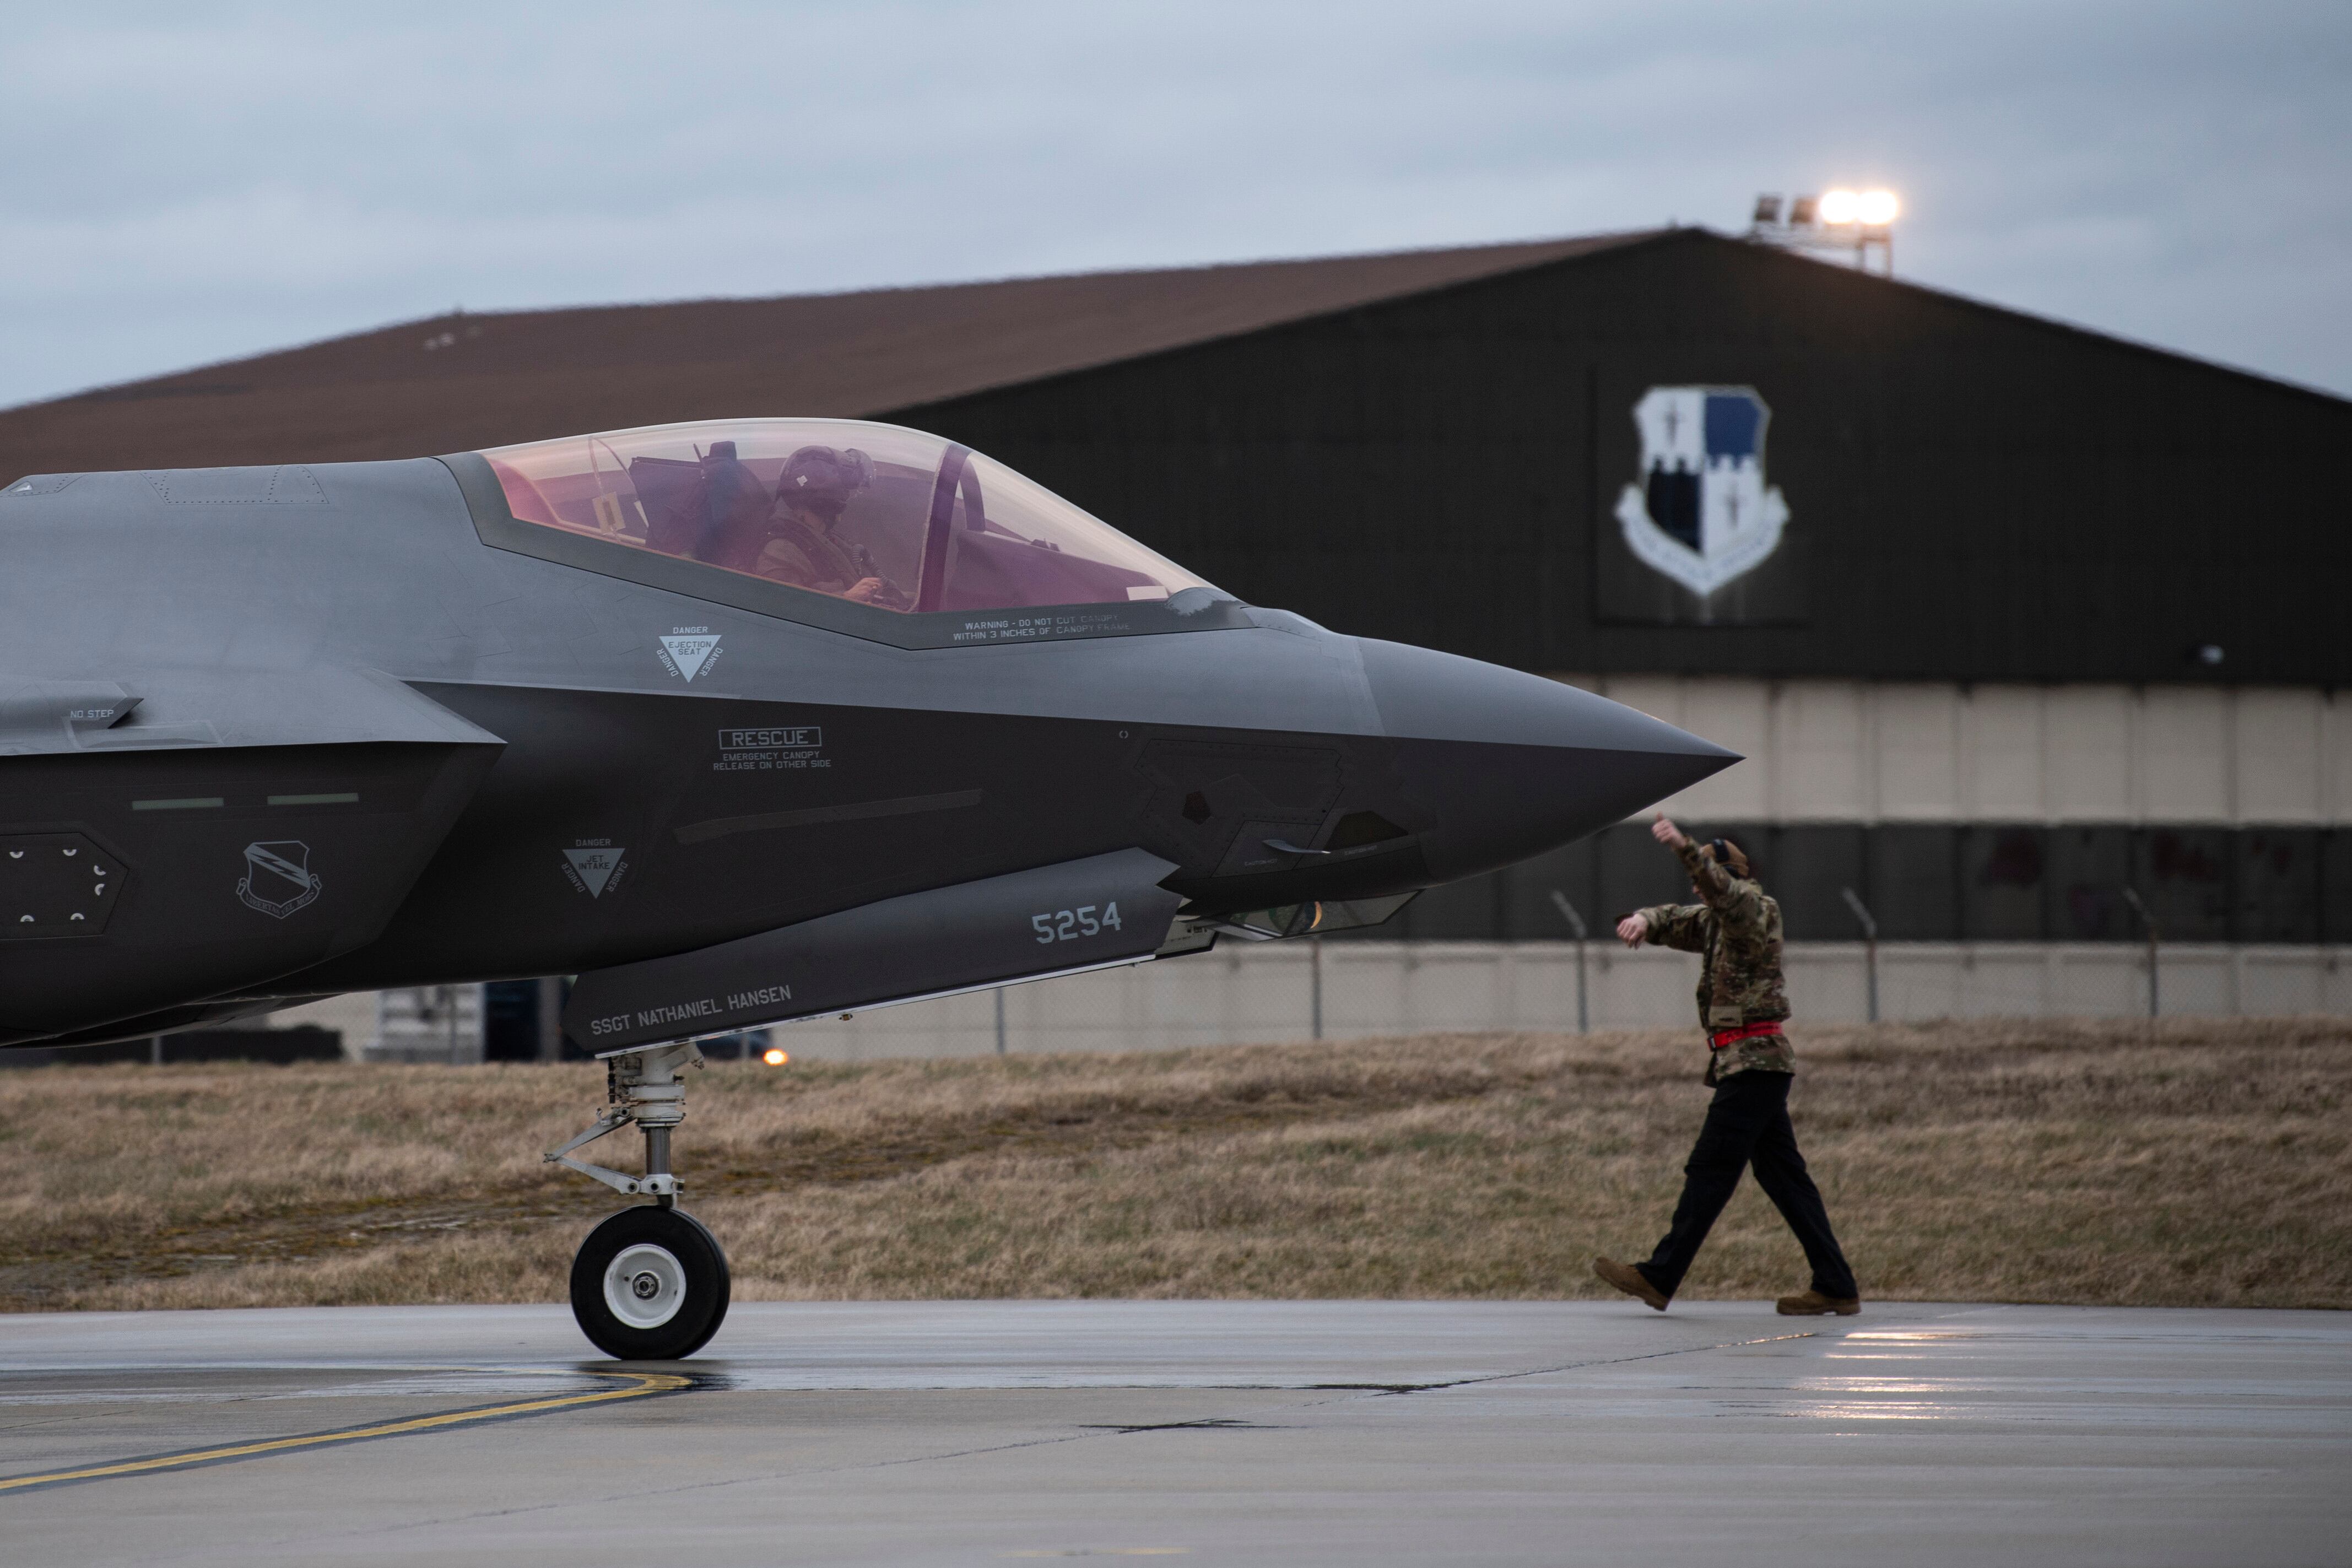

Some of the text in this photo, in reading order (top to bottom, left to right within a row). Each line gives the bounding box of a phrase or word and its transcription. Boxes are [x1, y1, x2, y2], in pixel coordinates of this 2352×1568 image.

[965, 620, 1009, 630] WARNING
[1018, 619, 1031, 627] DO
[1034, 618, 1052, 626] NOT
[953, 631, 986, 640] WITHIN
[990, 630, 997, 639] 3
[1000, 628, 1036, 637] INCHES
[1056, 625, 1094, 634] CANOPY
[656, 648, 679, 677] DANGER
[699, 647, 723, 677] DANGER
[88, 709, 114, 718] STEP
[732, 730, 809, 746] RESCUE
[723, 750, 820, 761] EMERGENCY CANOPY
[713, 759, 832, 770] RELEASE ON OTHER SIDE
[575, 838, 612, 847] DANGER
[561, 862, 586, 893] DANGER
[605, 861, 629, 892] DANGER
[1031, 901, 1122, 944] 5254
[591, 985, 792, 1035] SSGT NATHANIEL HANSEN
